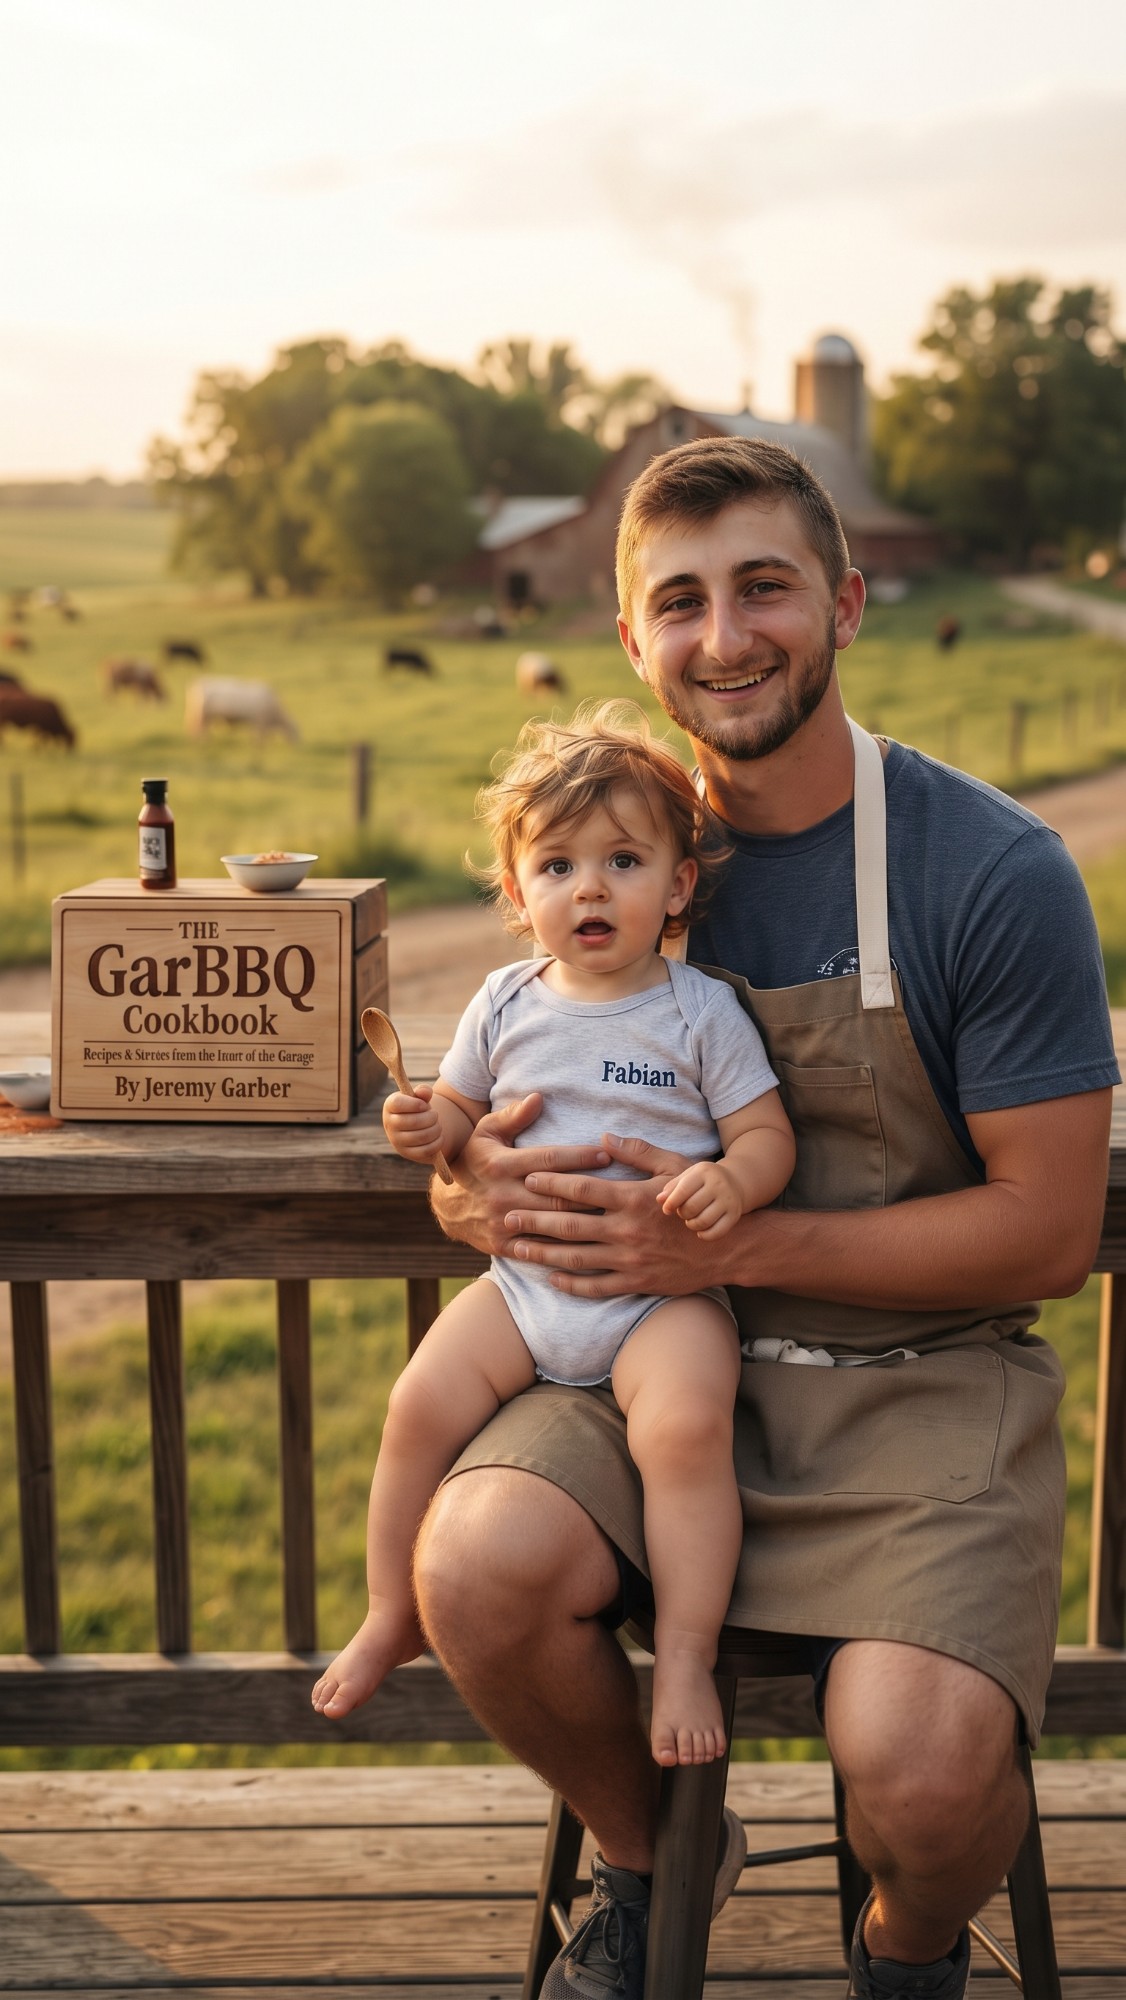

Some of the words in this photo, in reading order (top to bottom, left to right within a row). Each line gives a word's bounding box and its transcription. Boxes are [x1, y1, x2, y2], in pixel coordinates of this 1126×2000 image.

[178, 922, 220, 939] THE
[88, 944, 315, 1012] GarBBQ
[123, 1004, 279, 1036] Cookbook
[83, 1047, 122, 1064] Recipes
[124, 1049, 133, 1060] &
[198, 1048, 215, 1061] the
[245, 1049, 256, 1061] of
[258, 1049, 275, 1062] the
[278, 1049, 314, 1066] Garage
[601, 1060, 677, 1088] Fabian
[115, 1076, 141, 1102] By
[142, 1077, 216, 1103] Jeremy
[221, 1077, 291, 1099] Garber
